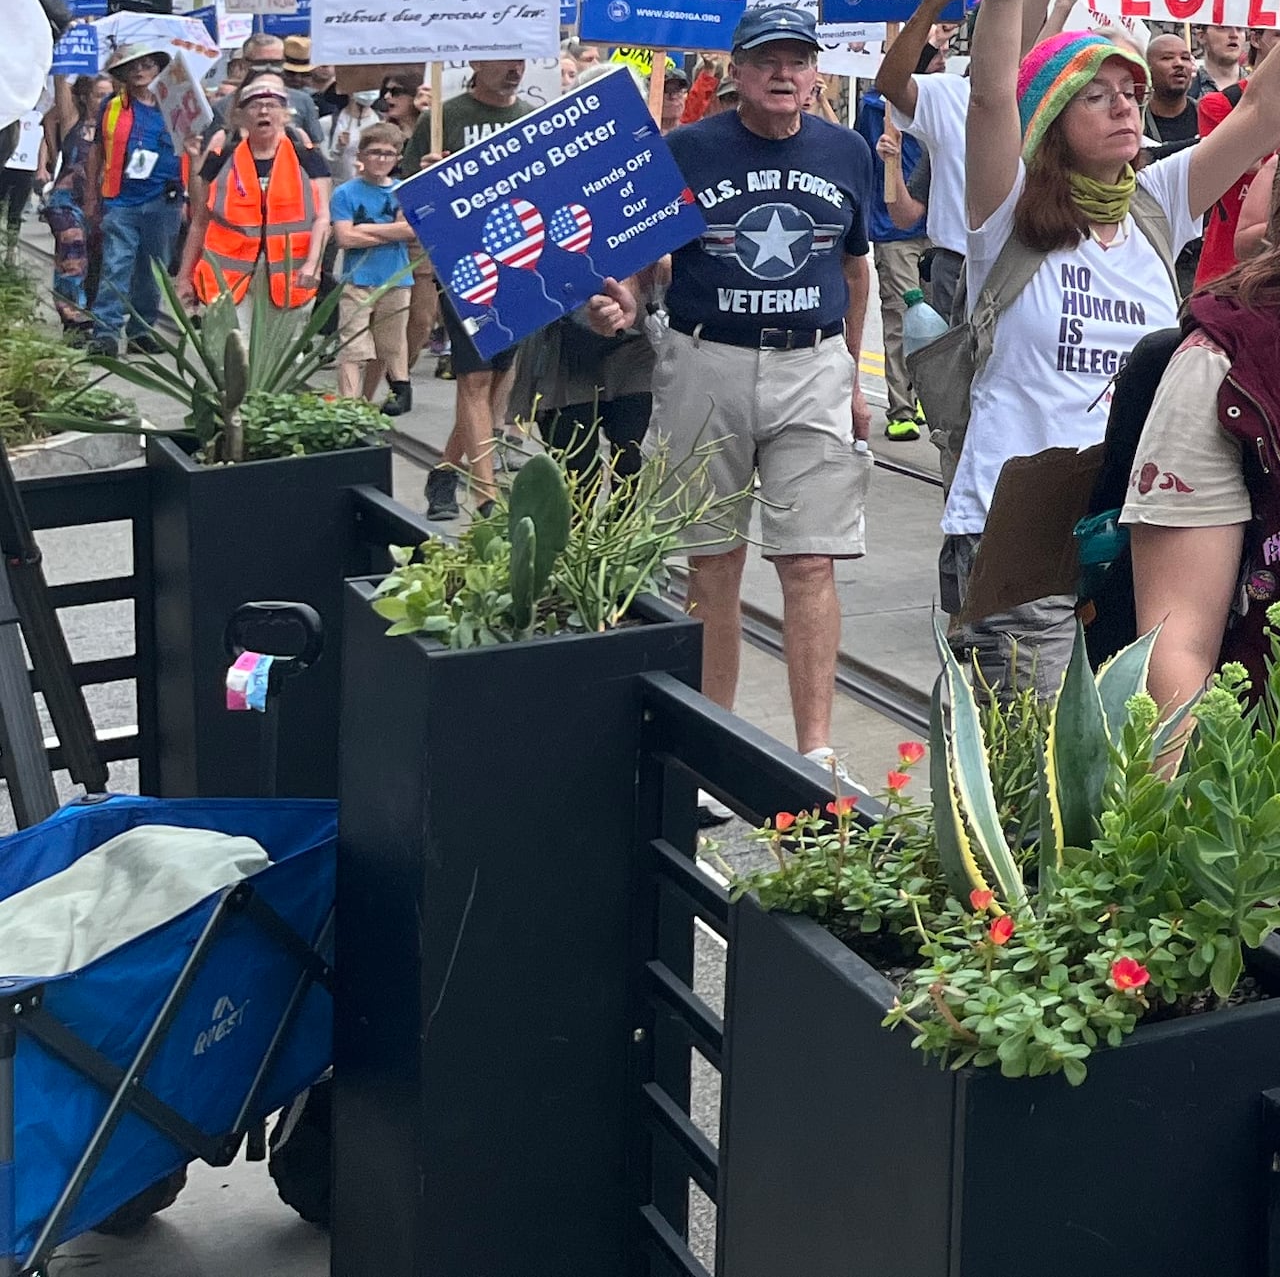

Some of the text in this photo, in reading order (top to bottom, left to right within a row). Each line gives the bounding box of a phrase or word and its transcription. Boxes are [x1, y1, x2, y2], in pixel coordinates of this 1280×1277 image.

[324, 5, 512, 26] without due process of
[437, 43, 459, 53] Fifth
[462, 43, 522, 52] Amendment
[816, 29, 866, 39] Amendment
[438, 159, 480, 188] We
[480, 135, 522, 167] the
[522, 92, 602, 145] People
[449, 161, 548, 219] Deserve
[547, 118, 617, 168] Better
[582, 149, 653, 196] Hands OFF
[620, 182, 637, 198] of
[698, 169, 844, 209] U.S. AIR FORCE
[622, 196, 648, 218] Our
[606, 201, 681, 250] Democracy
[1061, 263, 1091, 292] NO
[717, 286, 820, 315] VETERAN
[1062, 290, 1146, 325] HUMAN
[1058, 317, 1084, 345] IS
